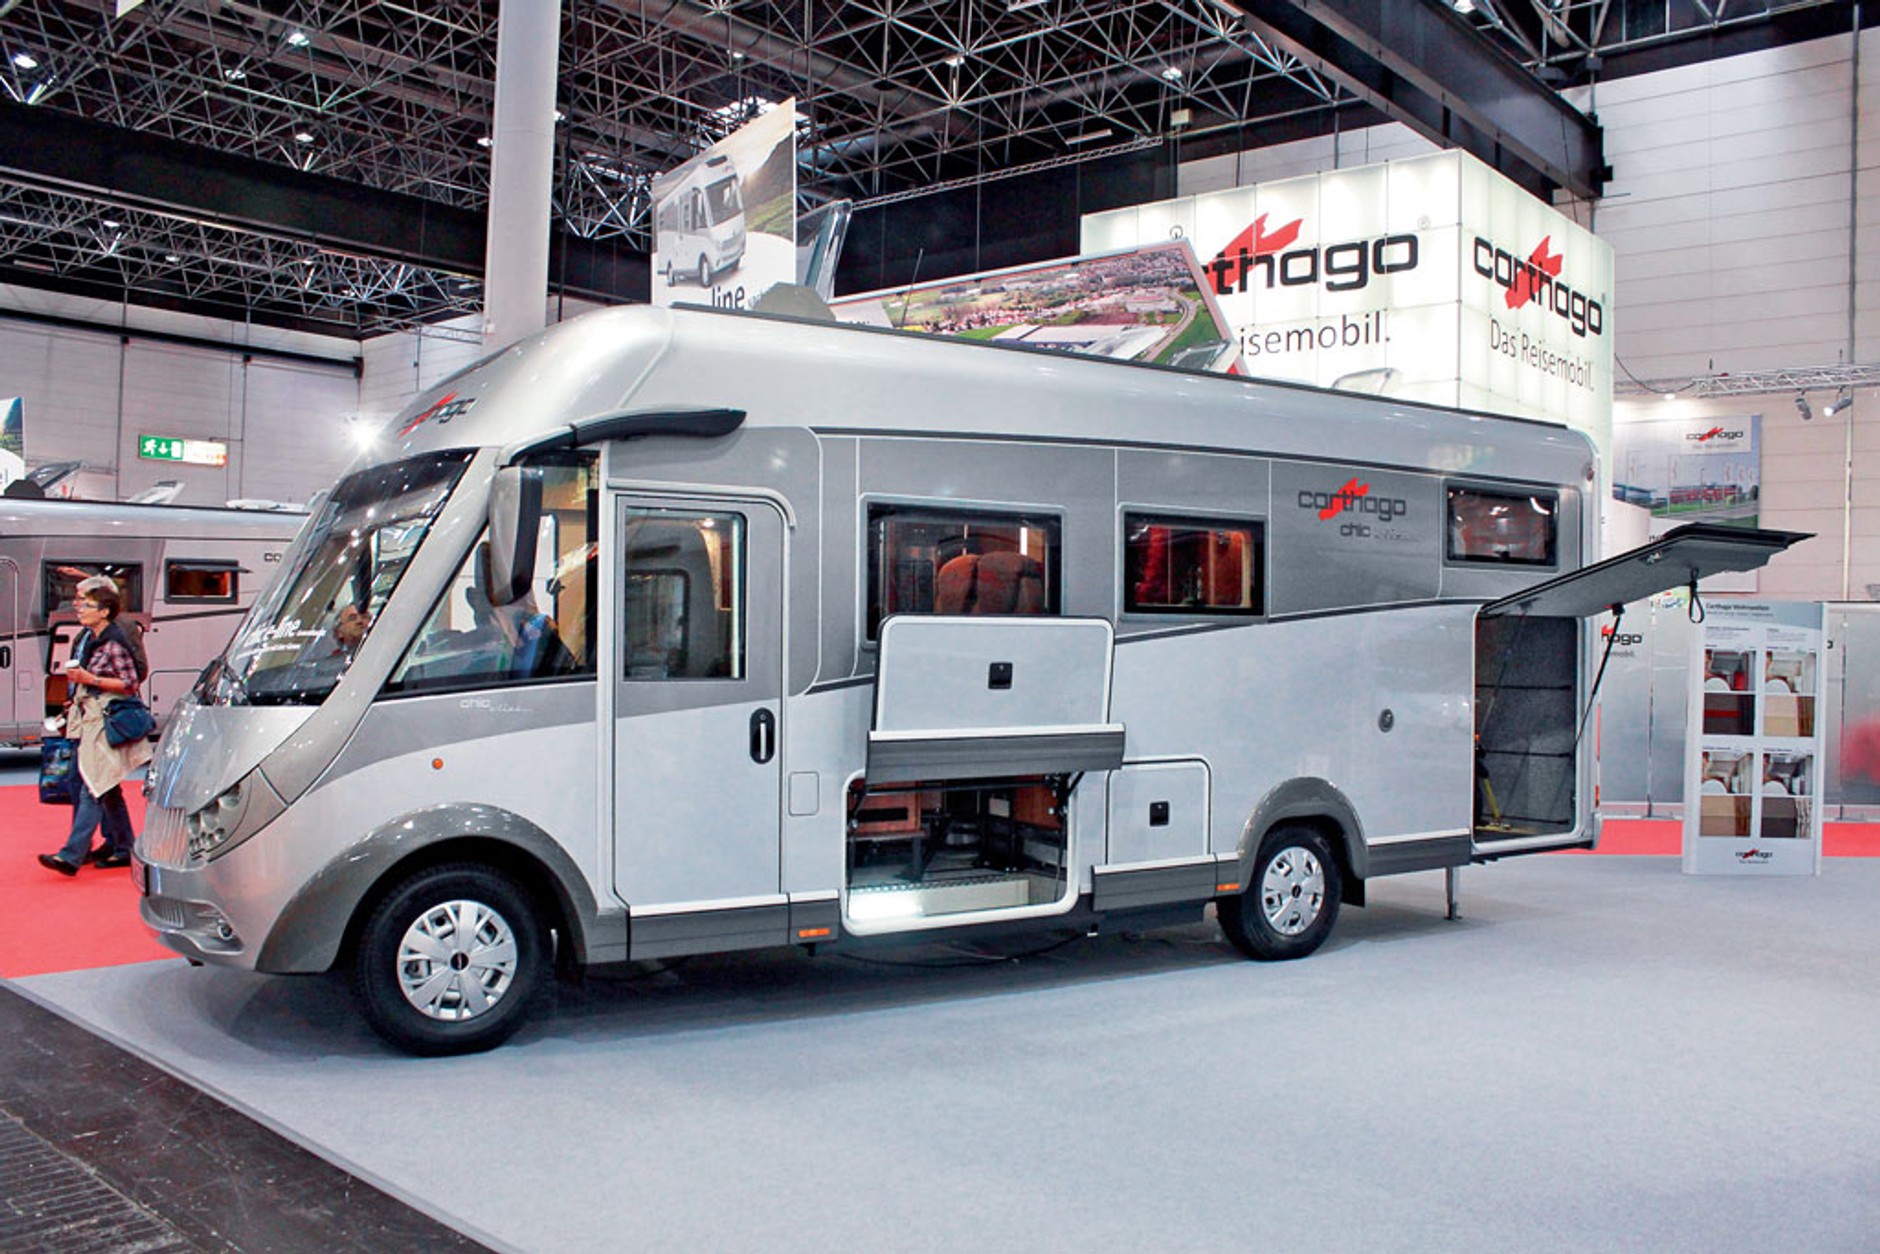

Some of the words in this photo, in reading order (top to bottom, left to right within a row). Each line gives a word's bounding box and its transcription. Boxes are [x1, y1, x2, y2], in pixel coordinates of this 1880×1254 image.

[1203, 234, 1418, 295] thago
[1474, 235, 1603, 338] carthago
[1239, 310, 1391, 356] isemobil.
[1490, 318, 1516, 358] Das
[1521, 332, 1594, 392] Reisemobil.
[1297, 488, 1407, 523] carthago
[1340, 522, 1371, 538] chic
